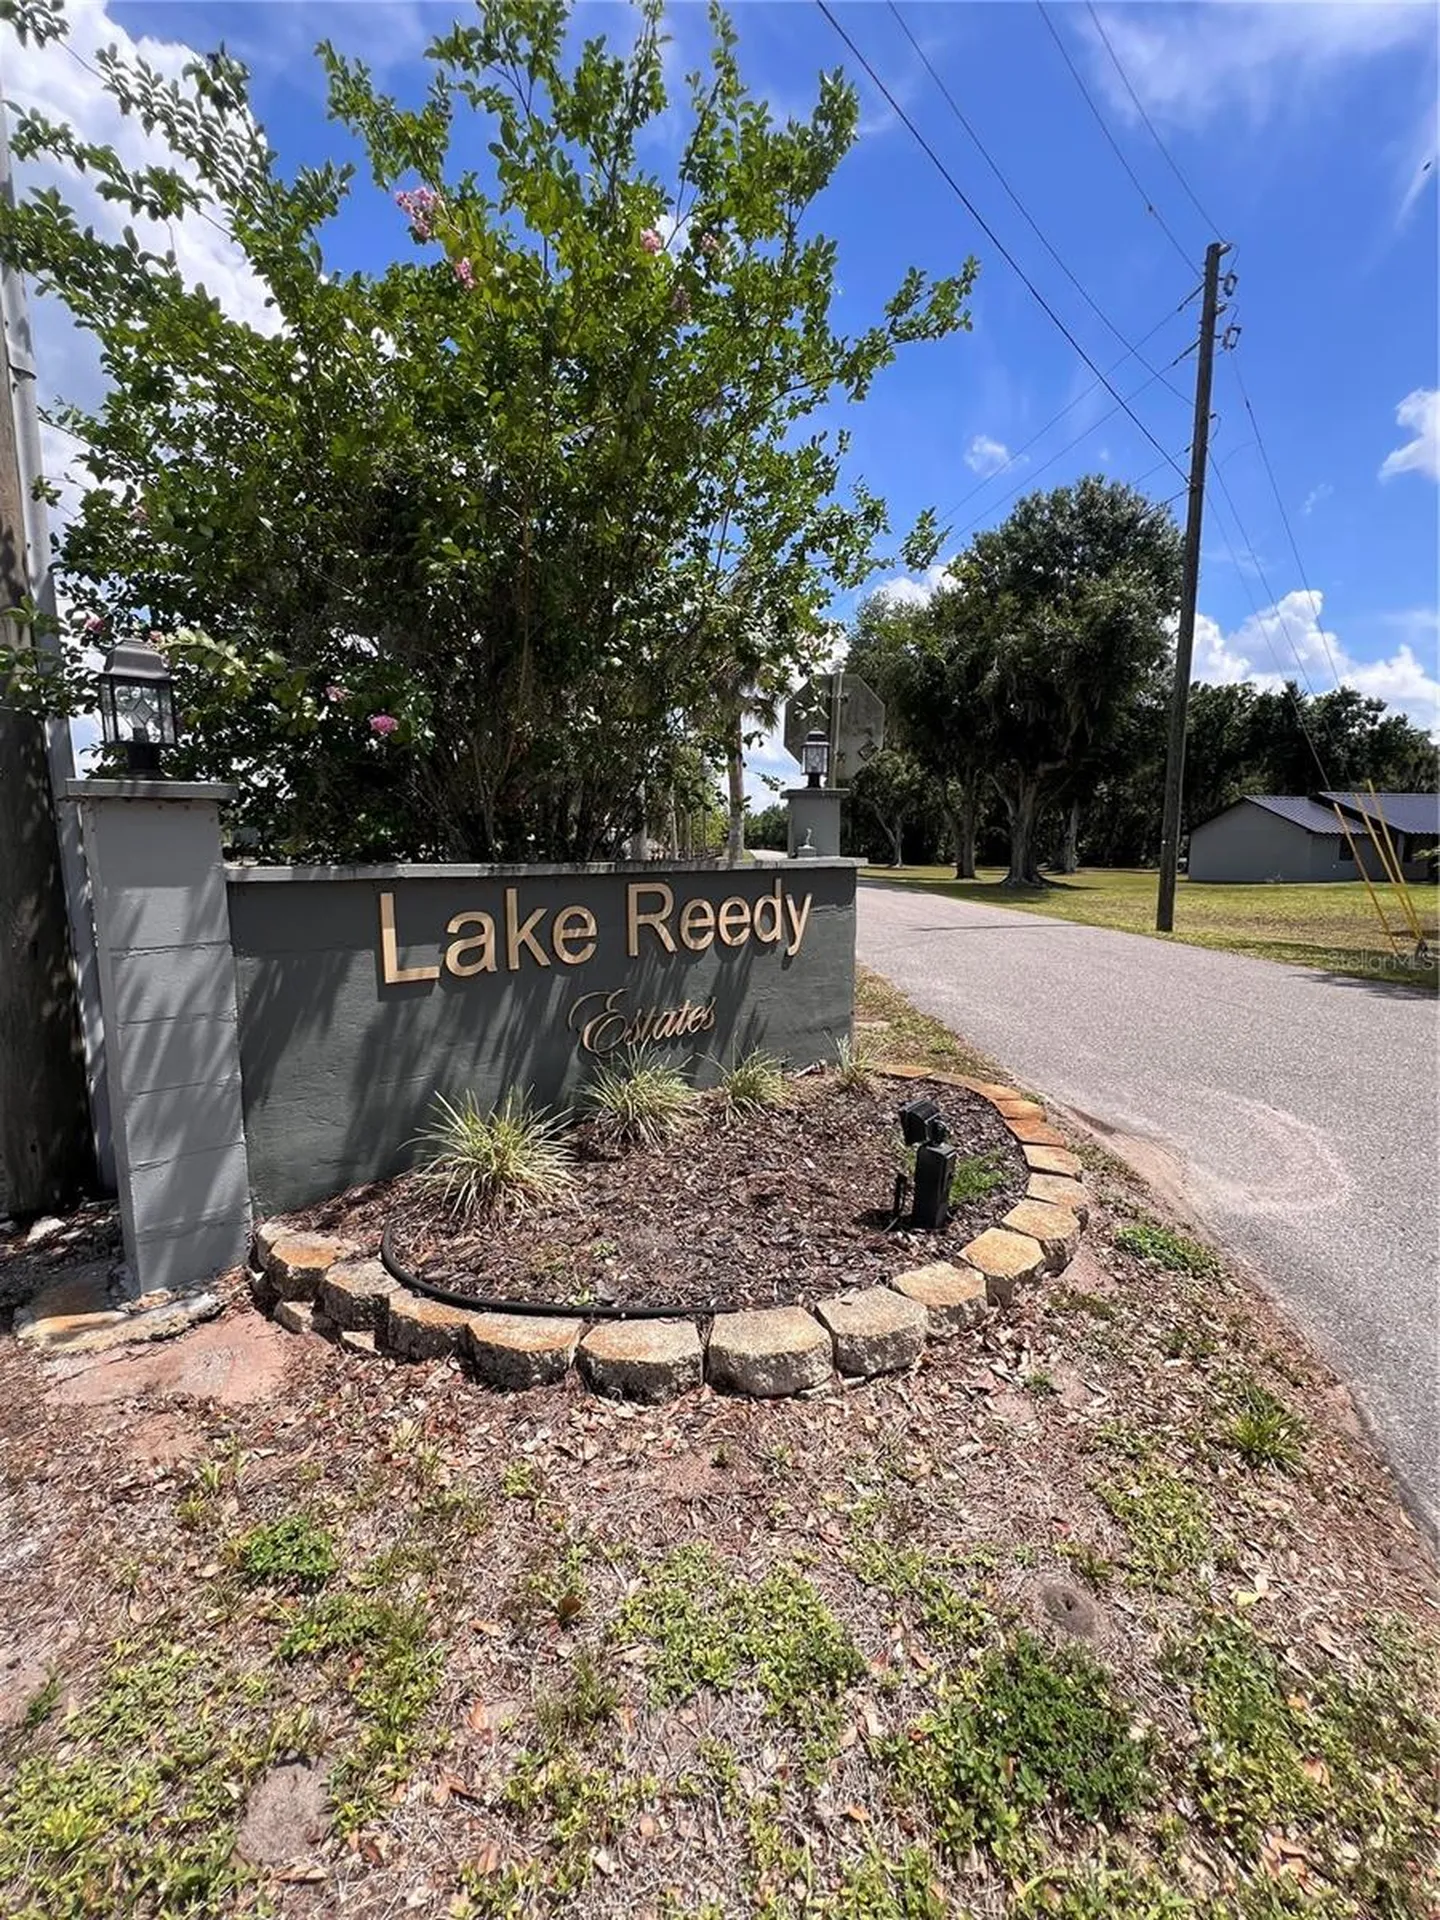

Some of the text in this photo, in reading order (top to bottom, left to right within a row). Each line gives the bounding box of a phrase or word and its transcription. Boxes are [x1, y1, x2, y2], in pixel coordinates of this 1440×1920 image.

[380, 878, 813, 984] Lake Reedy
[568, 987, 717, 1058] Estates
